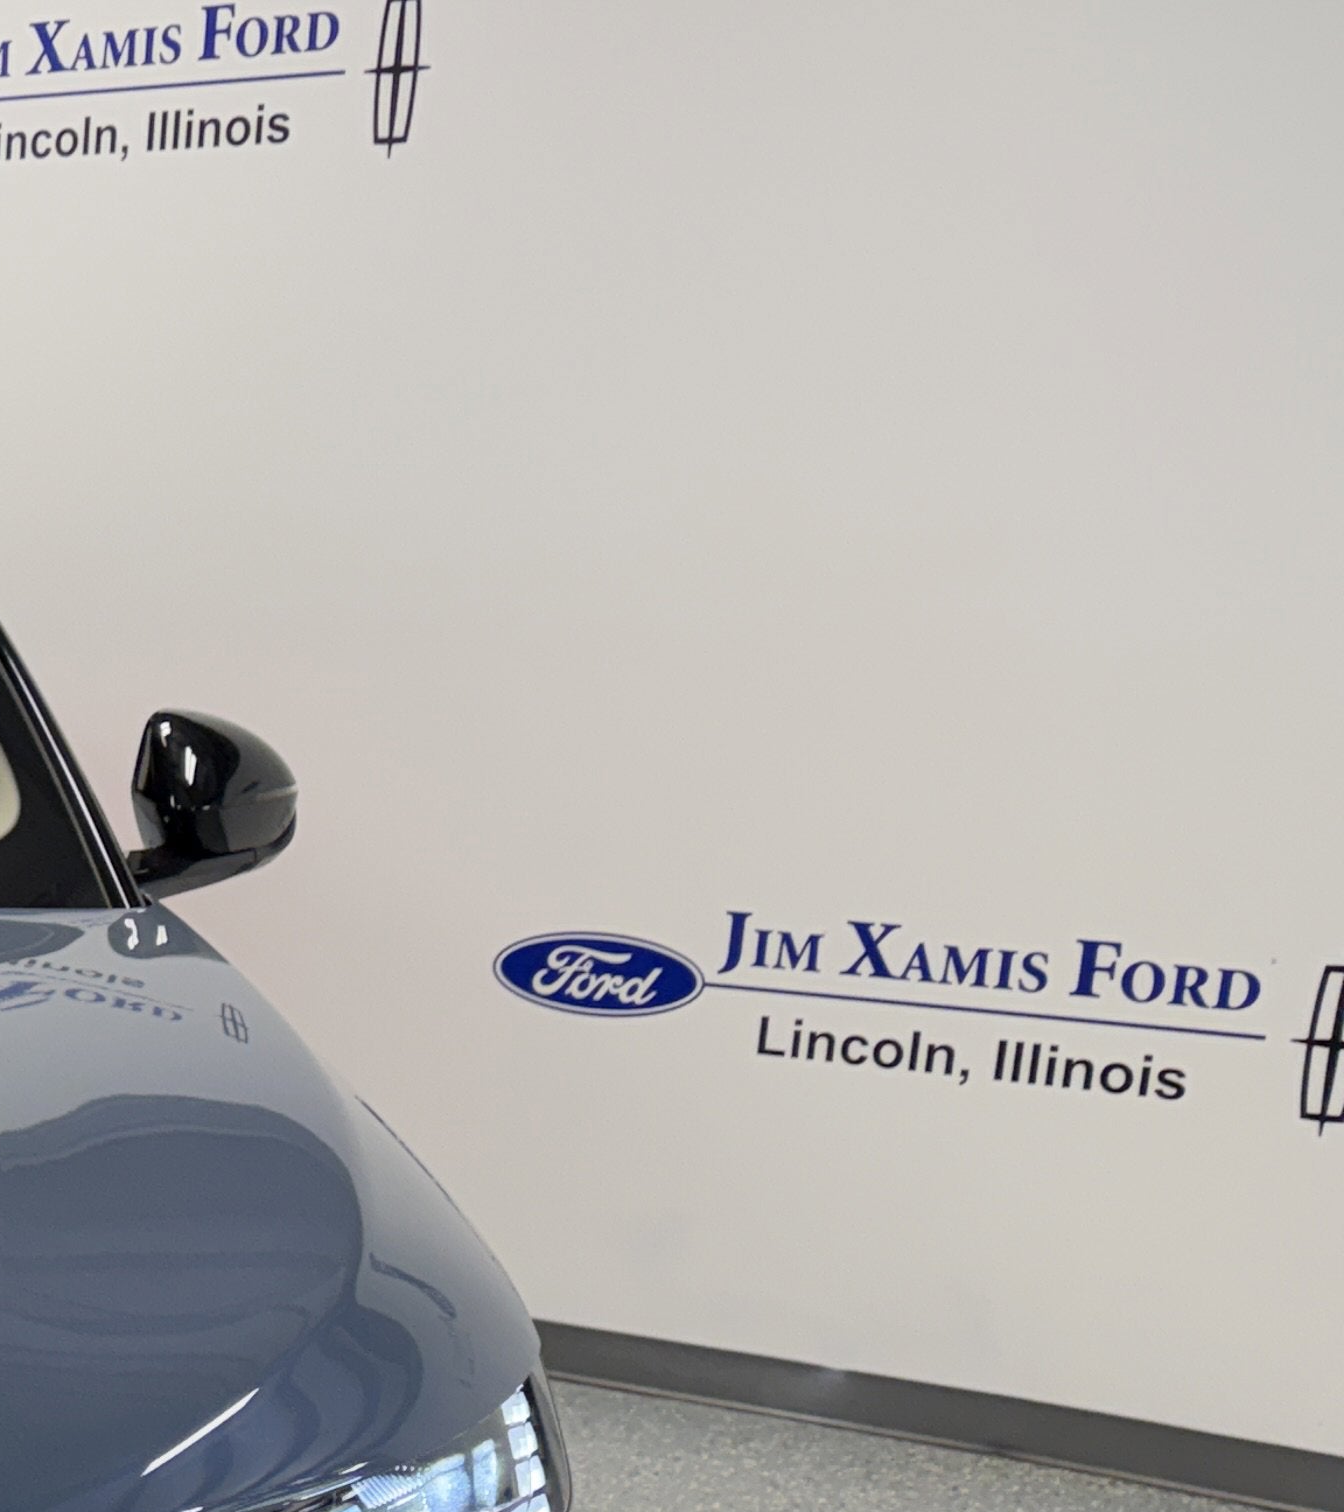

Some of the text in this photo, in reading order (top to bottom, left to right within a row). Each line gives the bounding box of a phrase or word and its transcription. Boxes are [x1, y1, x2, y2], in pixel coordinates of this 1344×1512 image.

[26, 19, 182, 76] XAMIS
[198, 3, 340, 61] FORD
[146, 103, 290, 152] Illinois
[532, 945, 663, 1006] Ford
[718, 911, 1261, 1011] JIM XAMIS FORD
[757, 1015, 1186, 1101] Lincoln, Illinois
